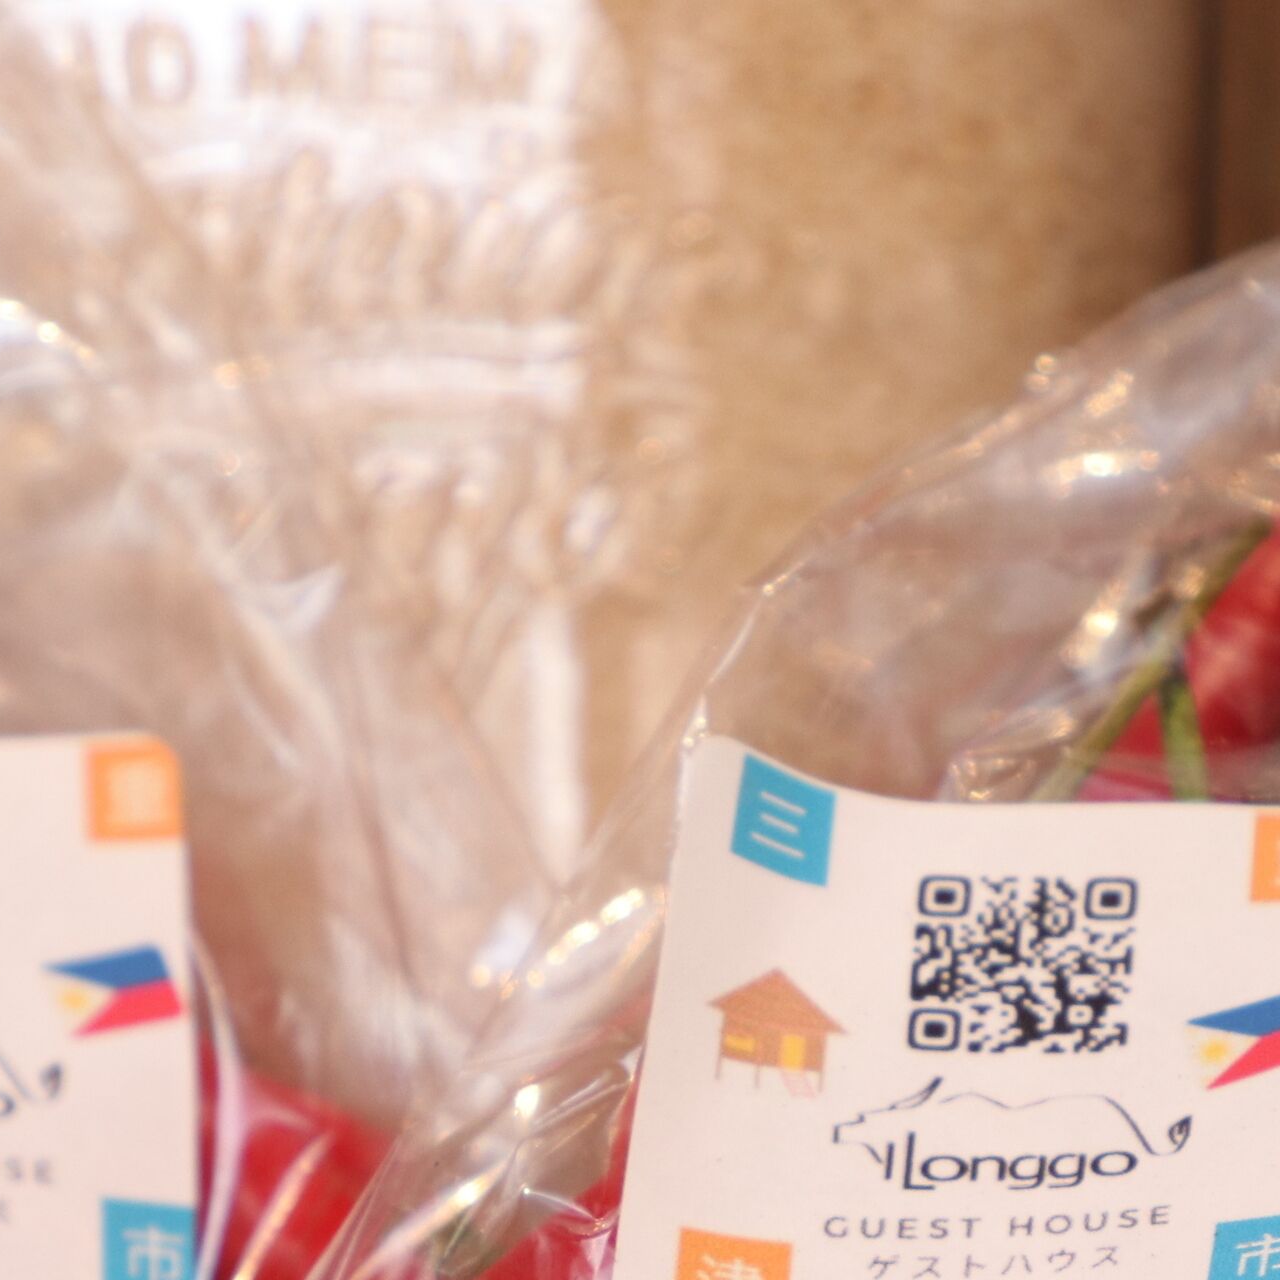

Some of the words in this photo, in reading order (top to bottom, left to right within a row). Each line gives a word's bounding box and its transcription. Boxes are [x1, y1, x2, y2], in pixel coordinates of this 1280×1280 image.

[750, 791, 808, 860] 三
[823, 1214, 982, 1240] GUEST
[1007, 1204, 1173, 1237] HOUSE
[867, 1245, 1120, 1280] ゲストハウス
